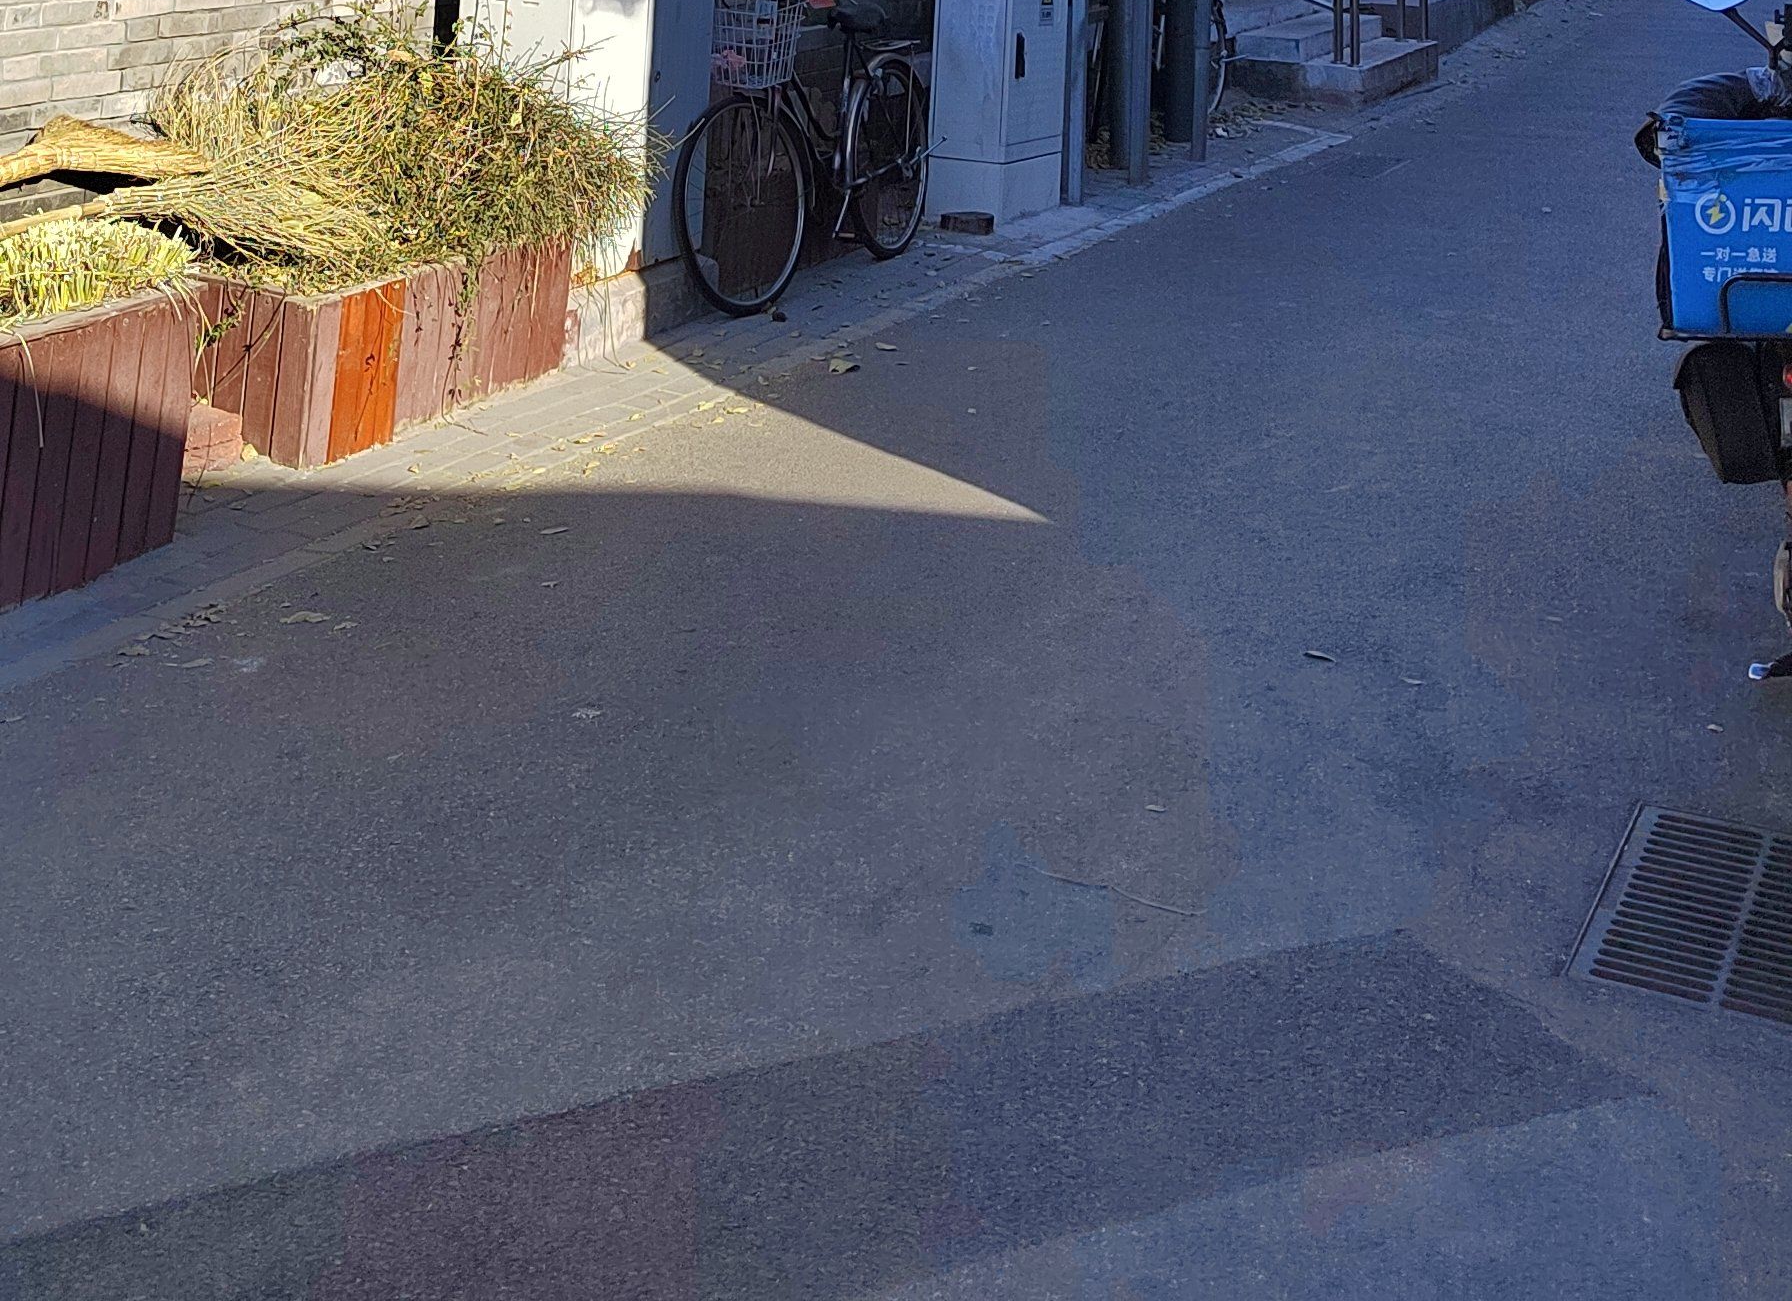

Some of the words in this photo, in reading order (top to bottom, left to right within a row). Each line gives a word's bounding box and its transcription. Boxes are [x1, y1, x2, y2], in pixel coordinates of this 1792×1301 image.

[1741, 198, 1792, 233] 闪
[1700, 246, 1777, 264] 一对一急送
